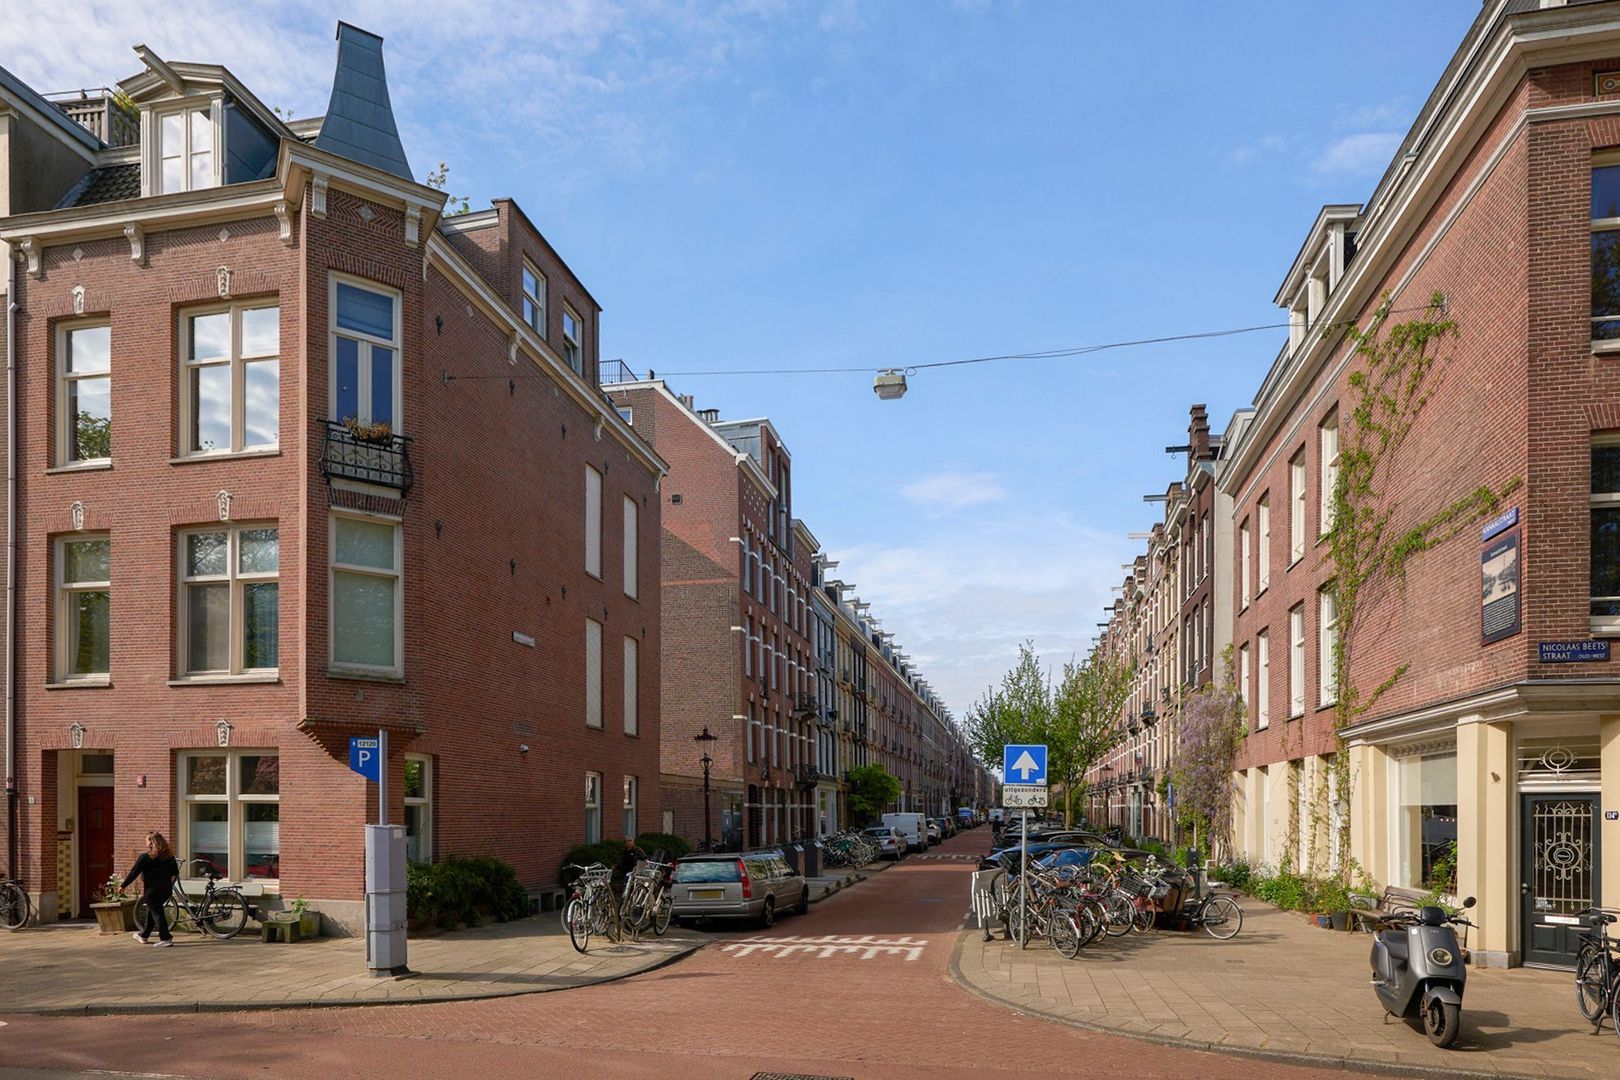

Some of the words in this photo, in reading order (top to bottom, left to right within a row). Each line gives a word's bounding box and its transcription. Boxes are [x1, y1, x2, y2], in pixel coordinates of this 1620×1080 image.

[1542, 643, 1580, 651] NICOLAAS
[1582, 641, 1606, 650] BEETS
[1542, 652, 1571, 660] STRAAT
[359, 750, 370, 767] P
